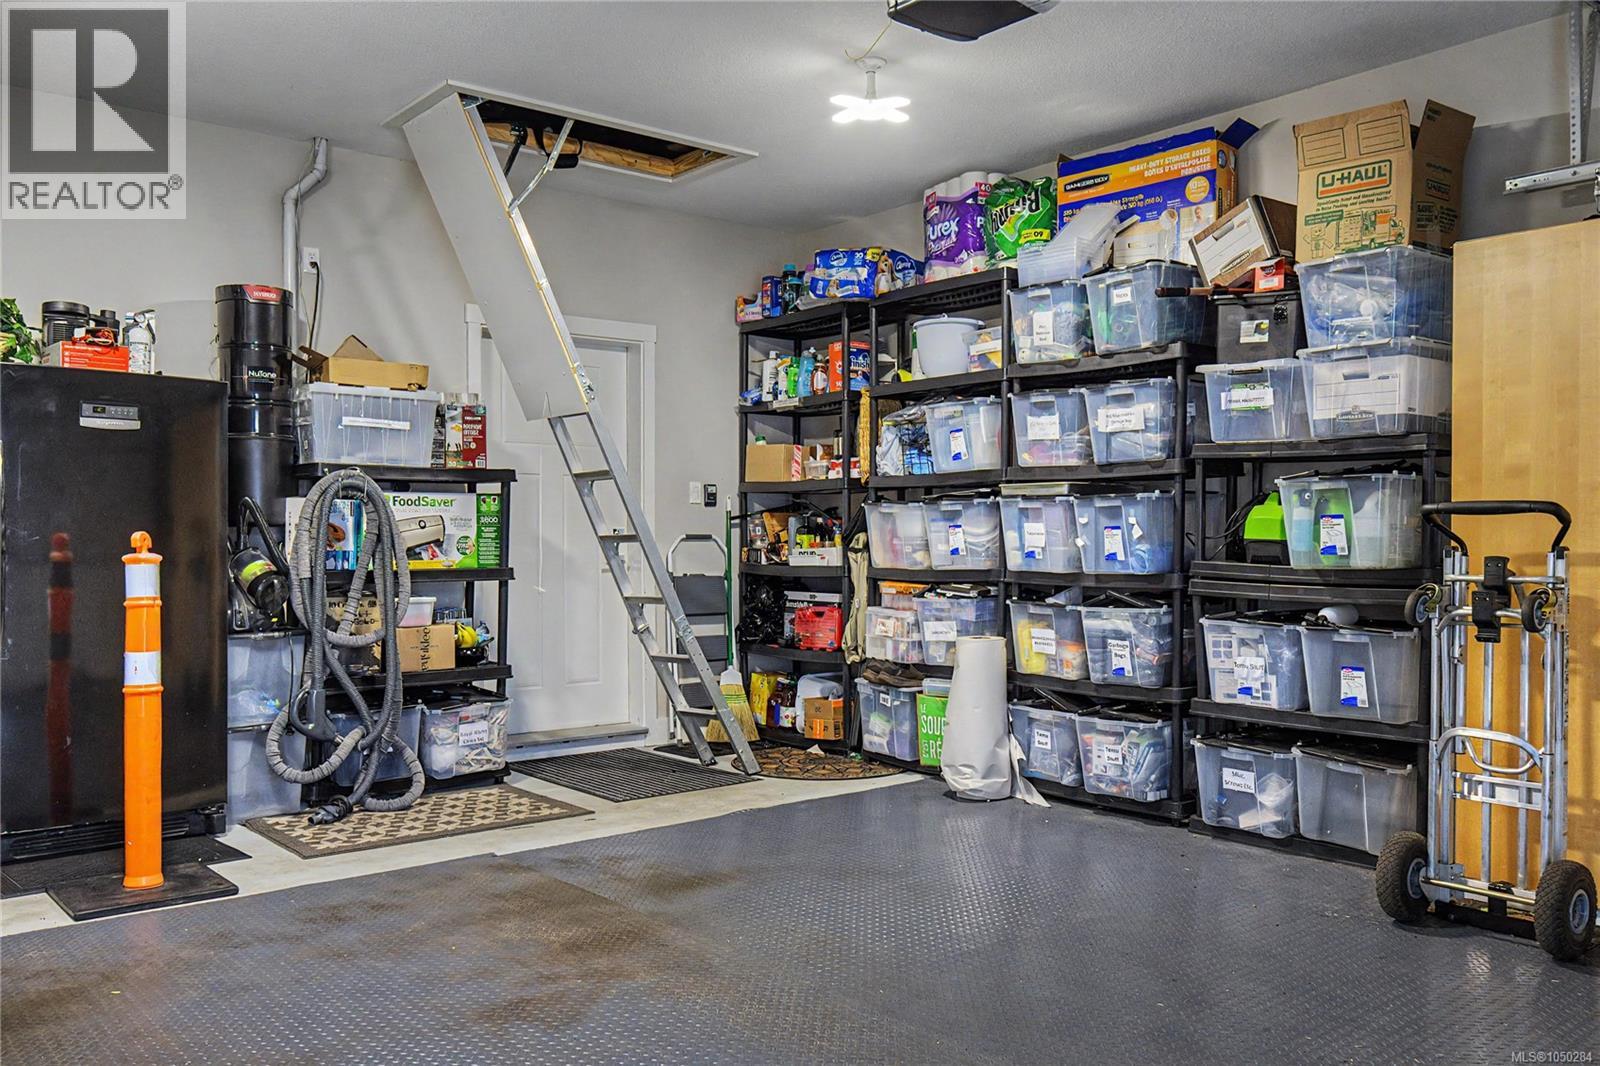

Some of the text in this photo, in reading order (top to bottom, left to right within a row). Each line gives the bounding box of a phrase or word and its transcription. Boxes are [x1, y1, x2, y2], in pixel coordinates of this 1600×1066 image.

[1321, 165, 1387, 188] U-HAUL
[980, 184, 992, 192] 40
[248, 370, 277, 378] NuTone
[392, 495, 456, 507] FoodSaver
[920, 703, 927, 713] LE
